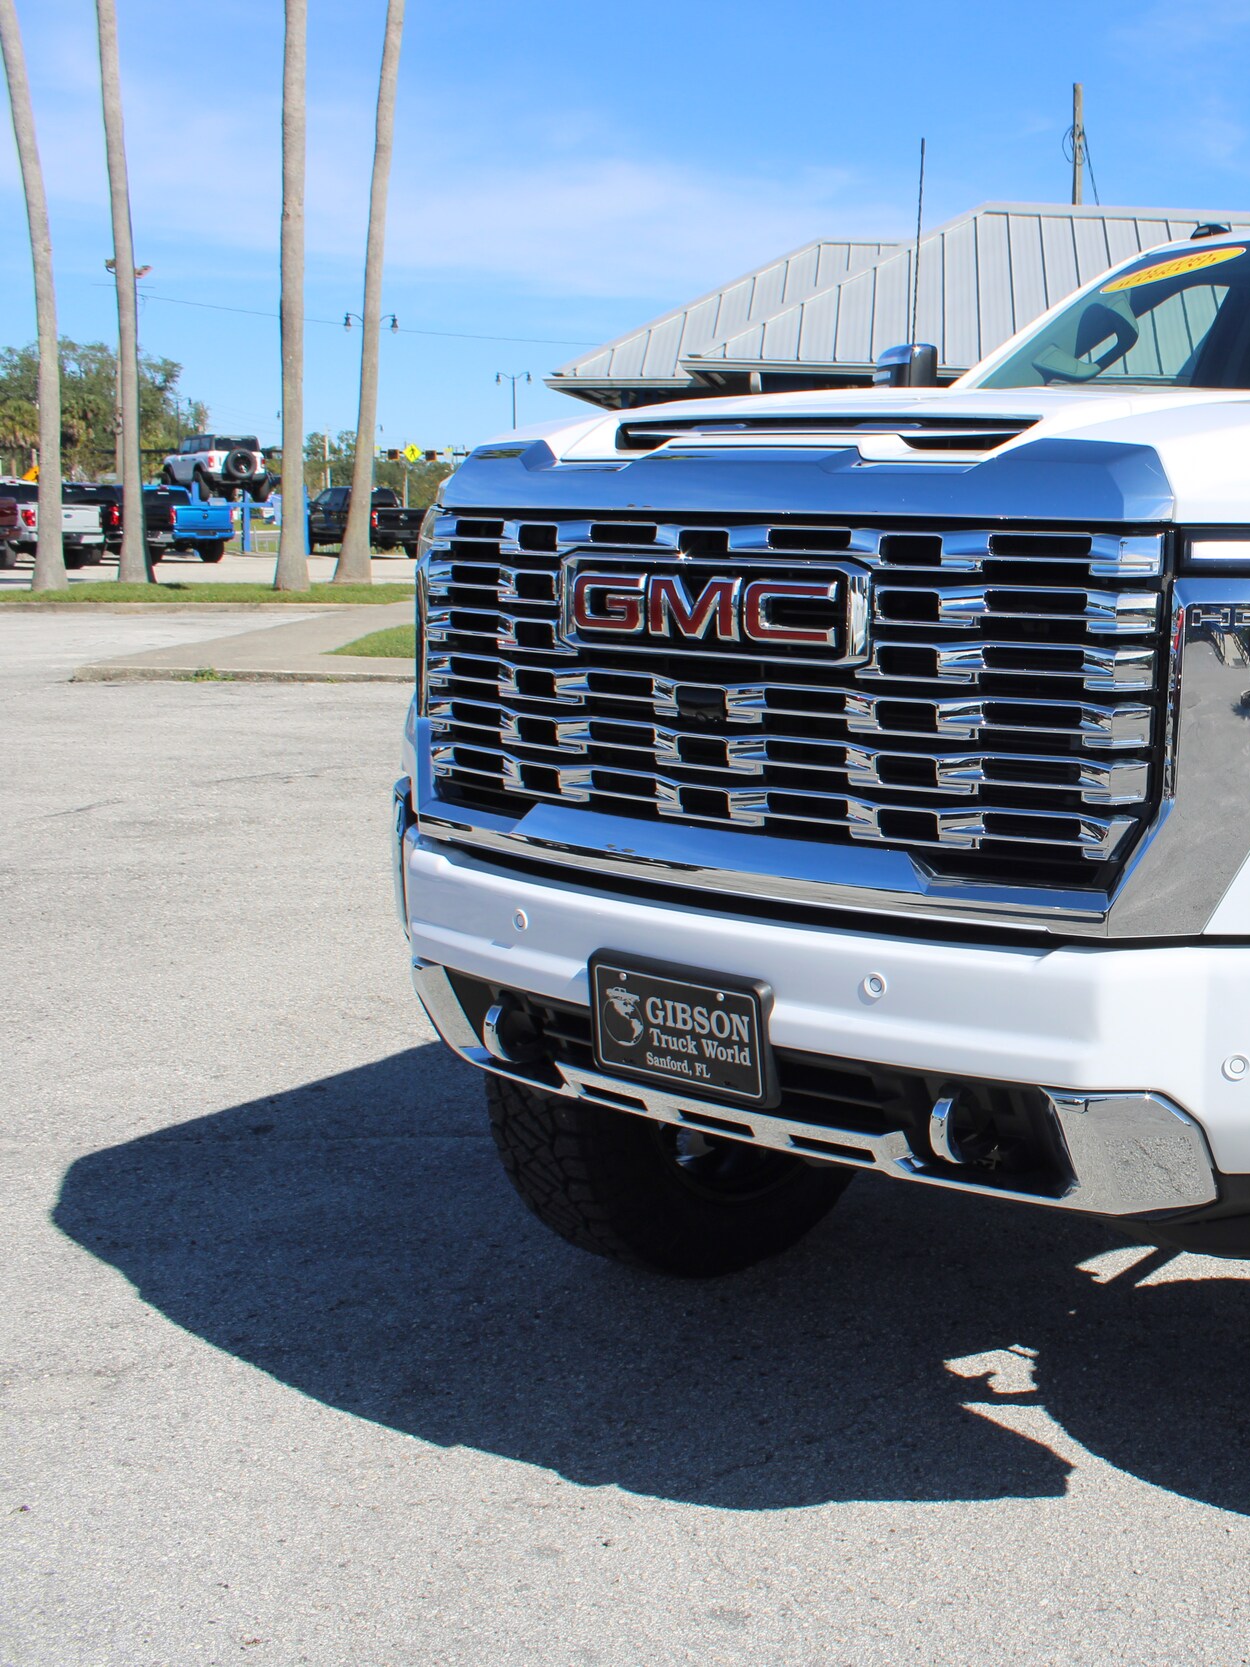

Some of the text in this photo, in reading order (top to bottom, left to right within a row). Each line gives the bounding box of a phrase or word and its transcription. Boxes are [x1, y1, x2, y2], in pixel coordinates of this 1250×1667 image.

[573, 570, 838, 648] GMC
[645, 996, 750, 1043] GIBSON
[646, 1052, 711, 1078] Sanford, FL
[650, 1028, 752, 1066] Truck World
